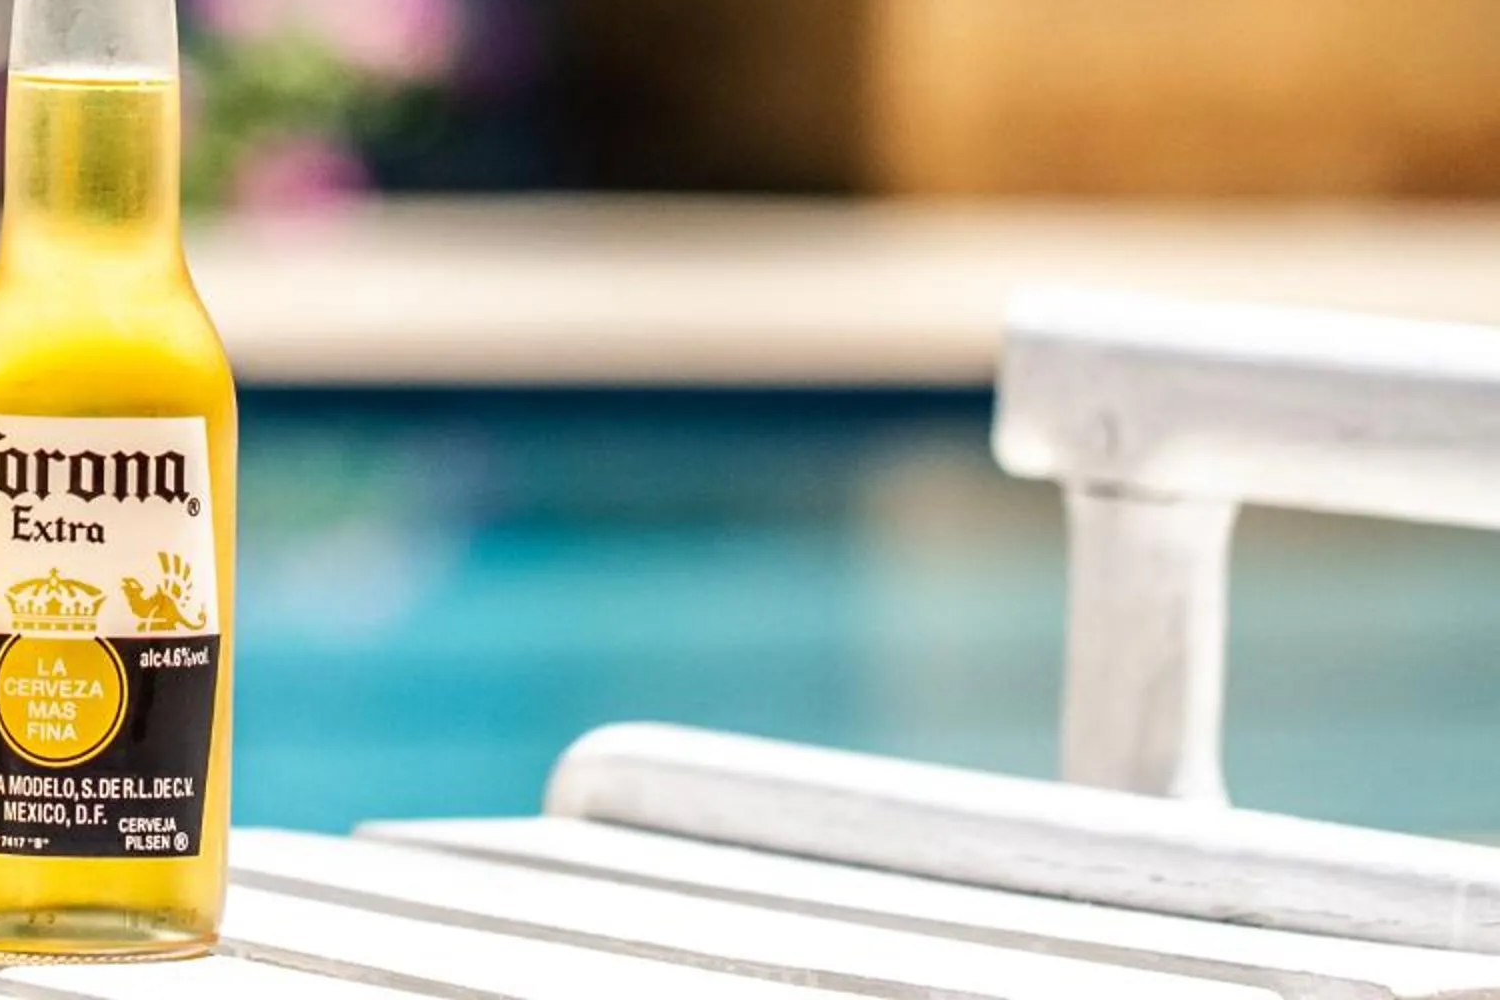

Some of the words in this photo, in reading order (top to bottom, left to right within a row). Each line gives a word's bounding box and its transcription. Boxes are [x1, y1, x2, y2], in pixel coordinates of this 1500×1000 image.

[12, 505, 105, 544] Extra
[37, 657, 67, 675] LA
[4, 678, 104, 697] CERVEZA
[28, 701, 77, 719] MAS
[27, 723, 77, 741] FINA
[8, 775, 80, 802] MODELO,
[3, 801, 71, 828] MEXICO,
[75, 803, 108, 825] D.F.
[118, 817, 177, 833] CERVEJA
[125, 834, 171, 851] PILSEN
